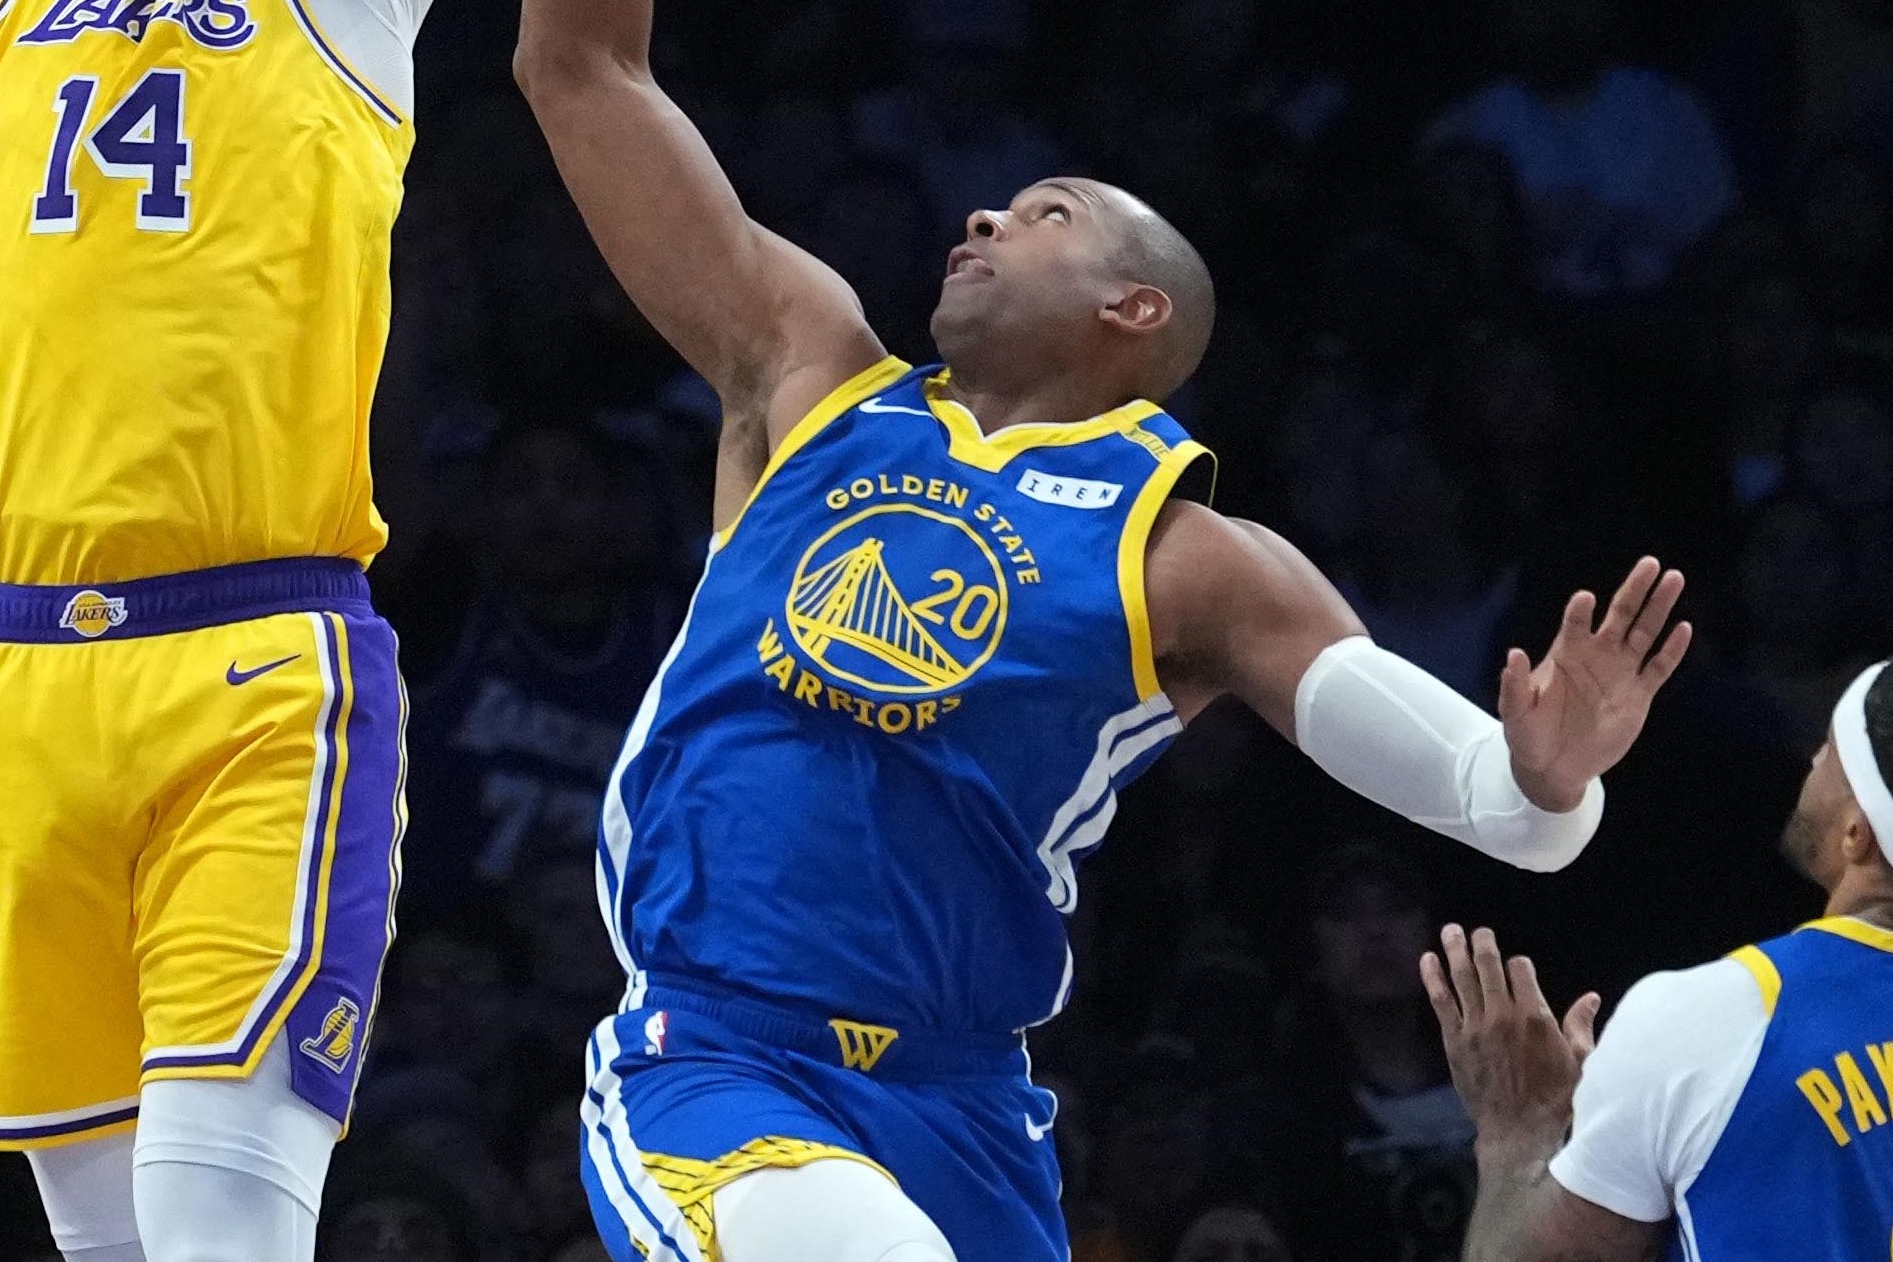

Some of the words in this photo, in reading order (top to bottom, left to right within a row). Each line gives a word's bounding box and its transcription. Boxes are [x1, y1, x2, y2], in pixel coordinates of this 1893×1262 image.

[31, 68, 191, 234] 14
[826, 474, 969, 511] GOLDEN
[974, 503, 1041, 586] STATE
[1027, 478, 1111, 501] IREN
[64, 603, 127, 625] LAKERS
[910, 568, 999, 640] 20
[756, 617, 962, 734] WARRIORS
